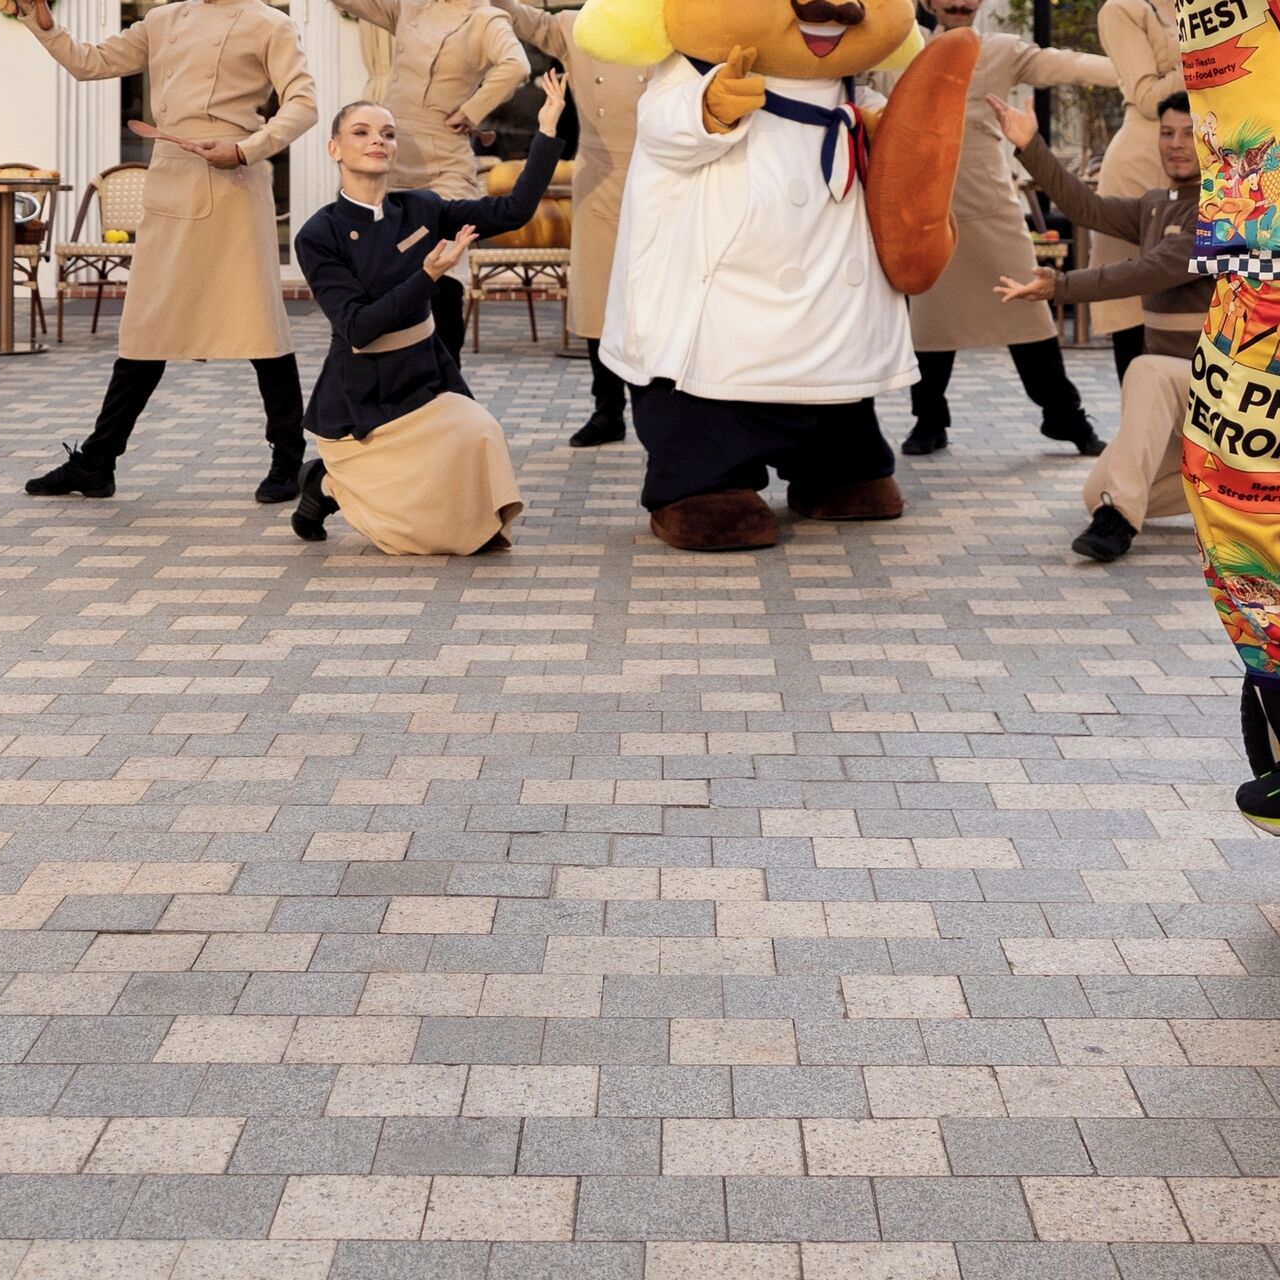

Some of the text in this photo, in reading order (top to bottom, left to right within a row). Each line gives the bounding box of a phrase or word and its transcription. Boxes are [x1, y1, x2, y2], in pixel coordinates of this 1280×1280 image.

[1195, 69, 1213, 80] Food
[1213, 63, 1236, 76] Party
[1217, 484, 1259, 502] Street
